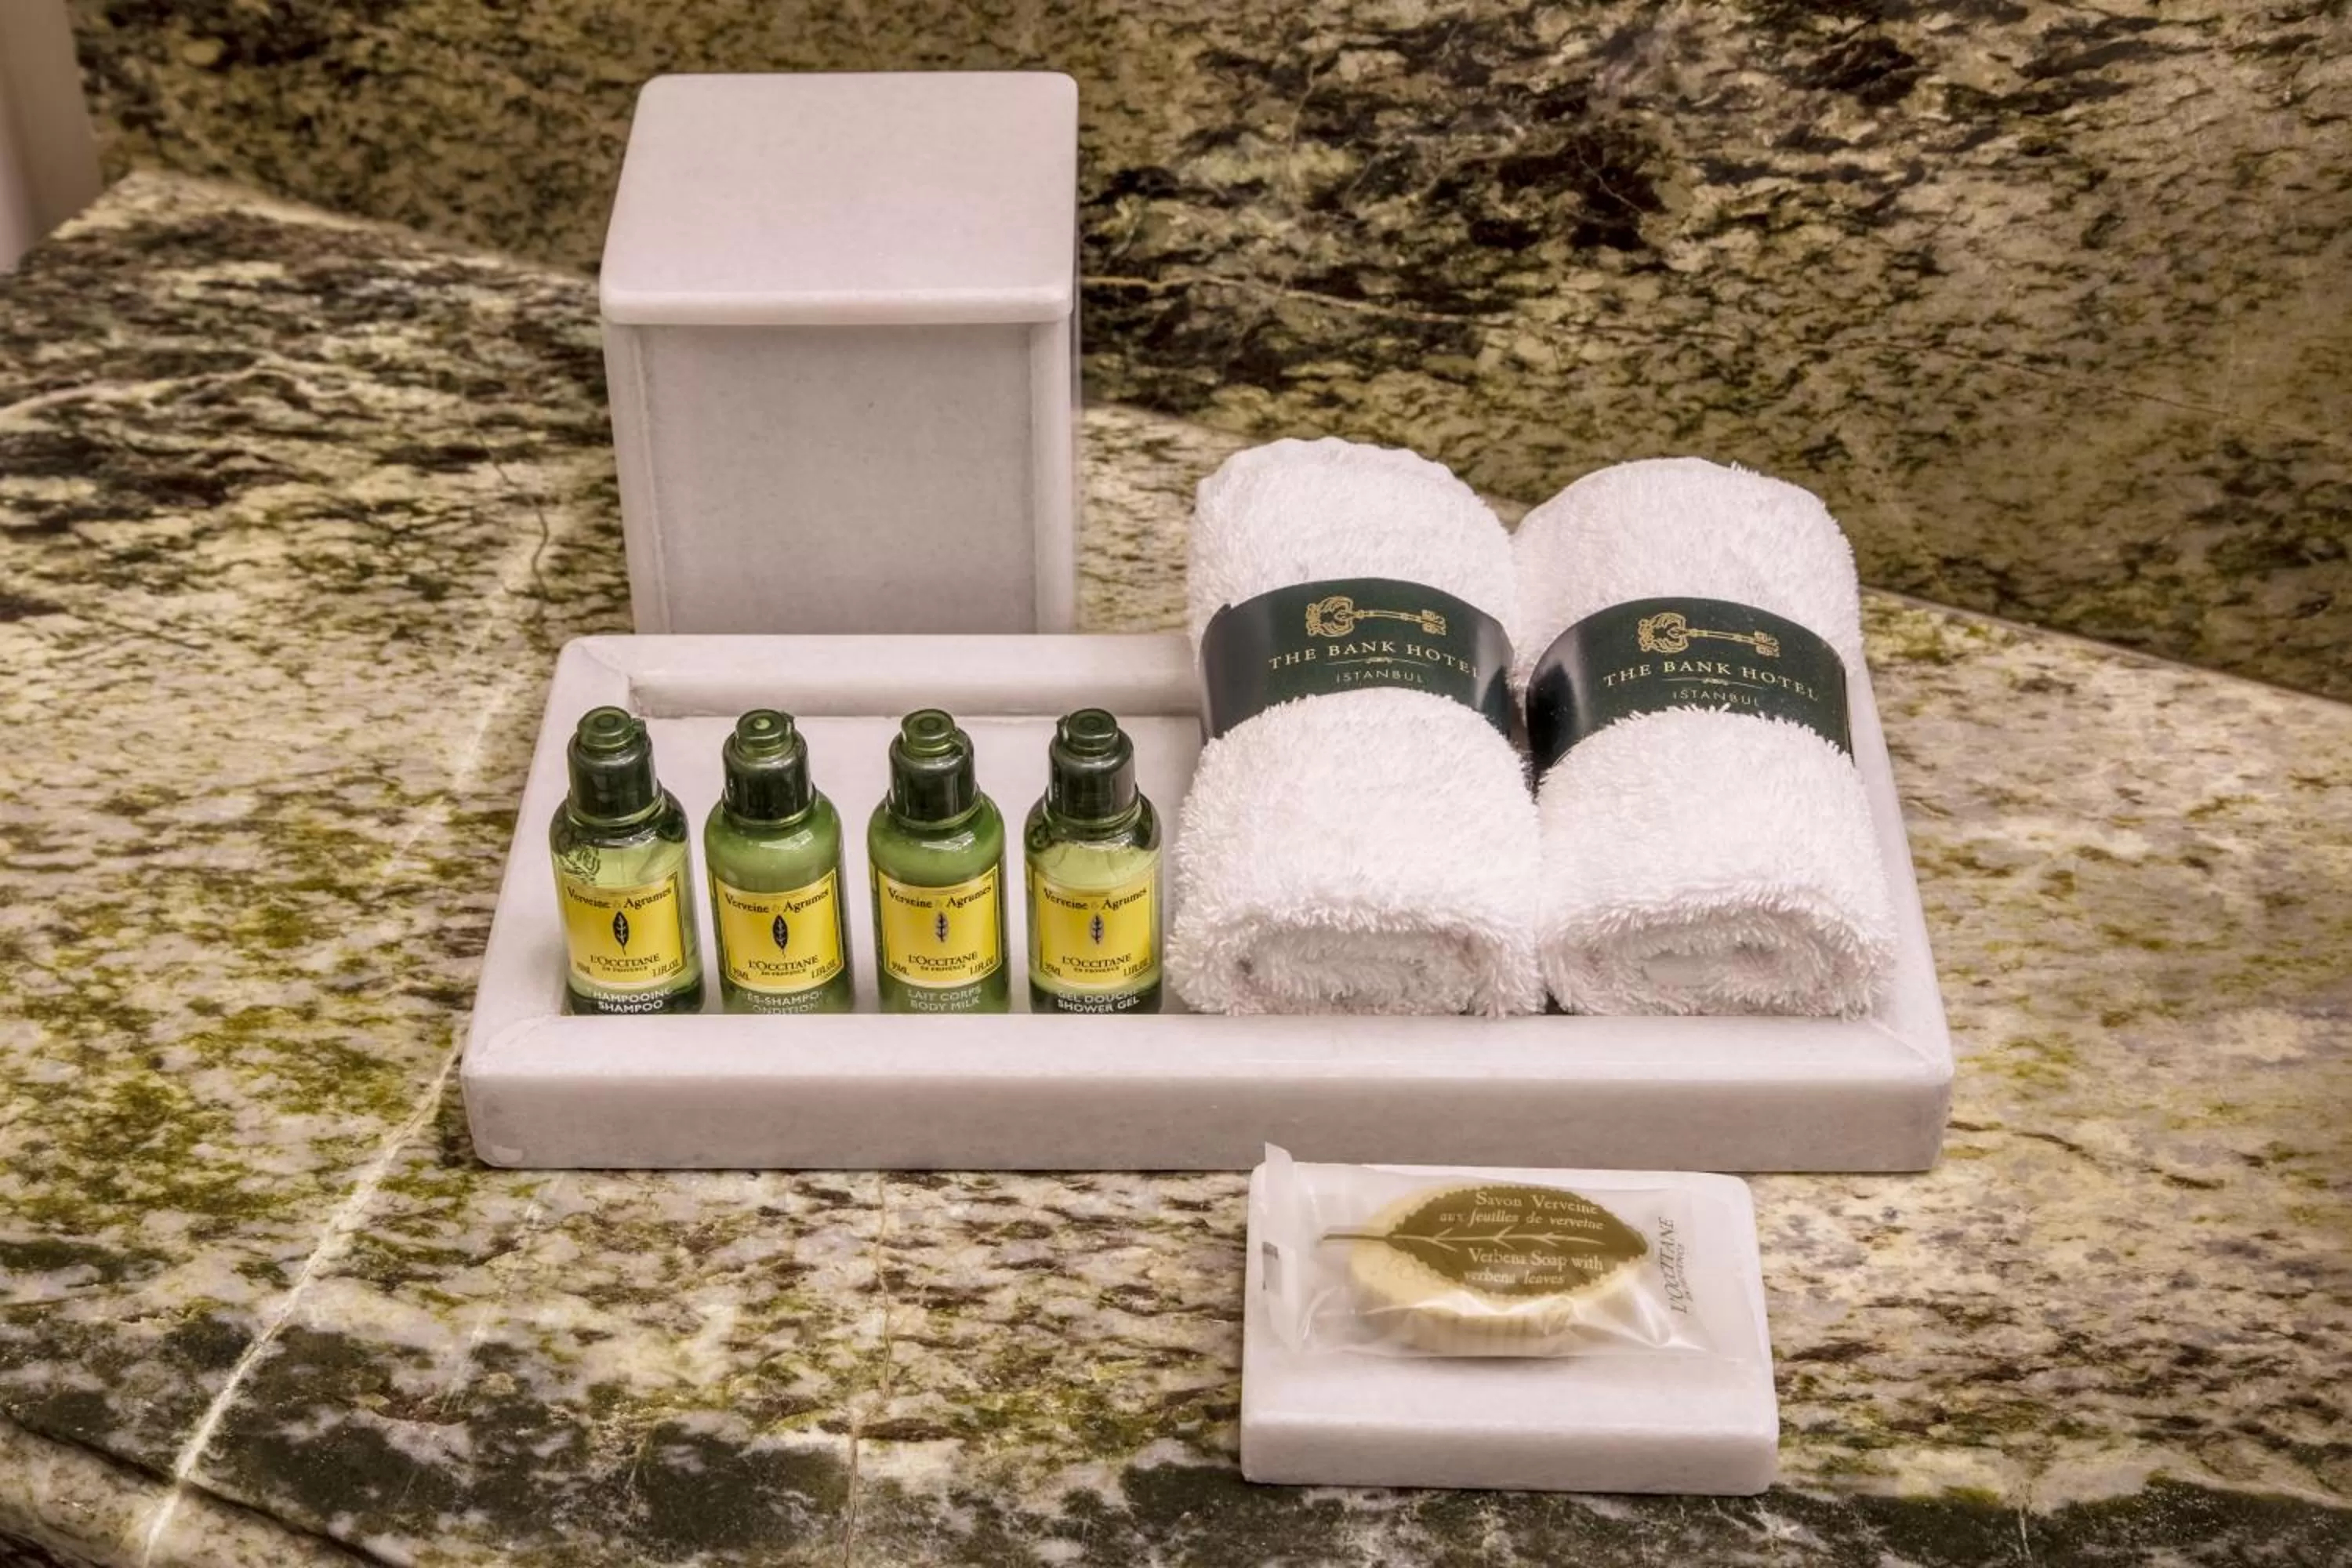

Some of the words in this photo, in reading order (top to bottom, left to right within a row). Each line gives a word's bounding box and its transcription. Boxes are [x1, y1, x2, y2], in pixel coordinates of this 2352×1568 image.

[1269, 648, 1317, 670] THE
[1328, 640, 1397, 657] BANK
[1406, 643, 1480, 678] HOTEL
[1603, 664, 1652, 687] THE
[1663, 660, 1731, 675] BANK
[1741, 666, 1820, 702] HOTEL
[724, 892, 769, 913] Verveine
[783, 887, 829, 913] Agrumes
[907, 988, 935, 1001] LAIT
[909, 999, 946, 1012] BODY
[950, 996, 982, 1011] MILK
[1057, 999, 1114, 1014] SHOWER
[1117, 996, 1141, 1011] GEL
[597, 1000, 663, 1014] SHAMPOO
[1475, 1191, 1523, 1207] Savon
[1531, 1194, 1599, 1215] Verveine
[1468, 1207, 1519, 1229] feuilles
[1525, 1212, 1543, 1225] de
[1548, 1216, 1605, 1231] verveine
[1530, 1250, 1567, 1272] Soap
[1570, 1254, 1604, 1271] with
[1523, 1270, 1565, 1285] leaves
